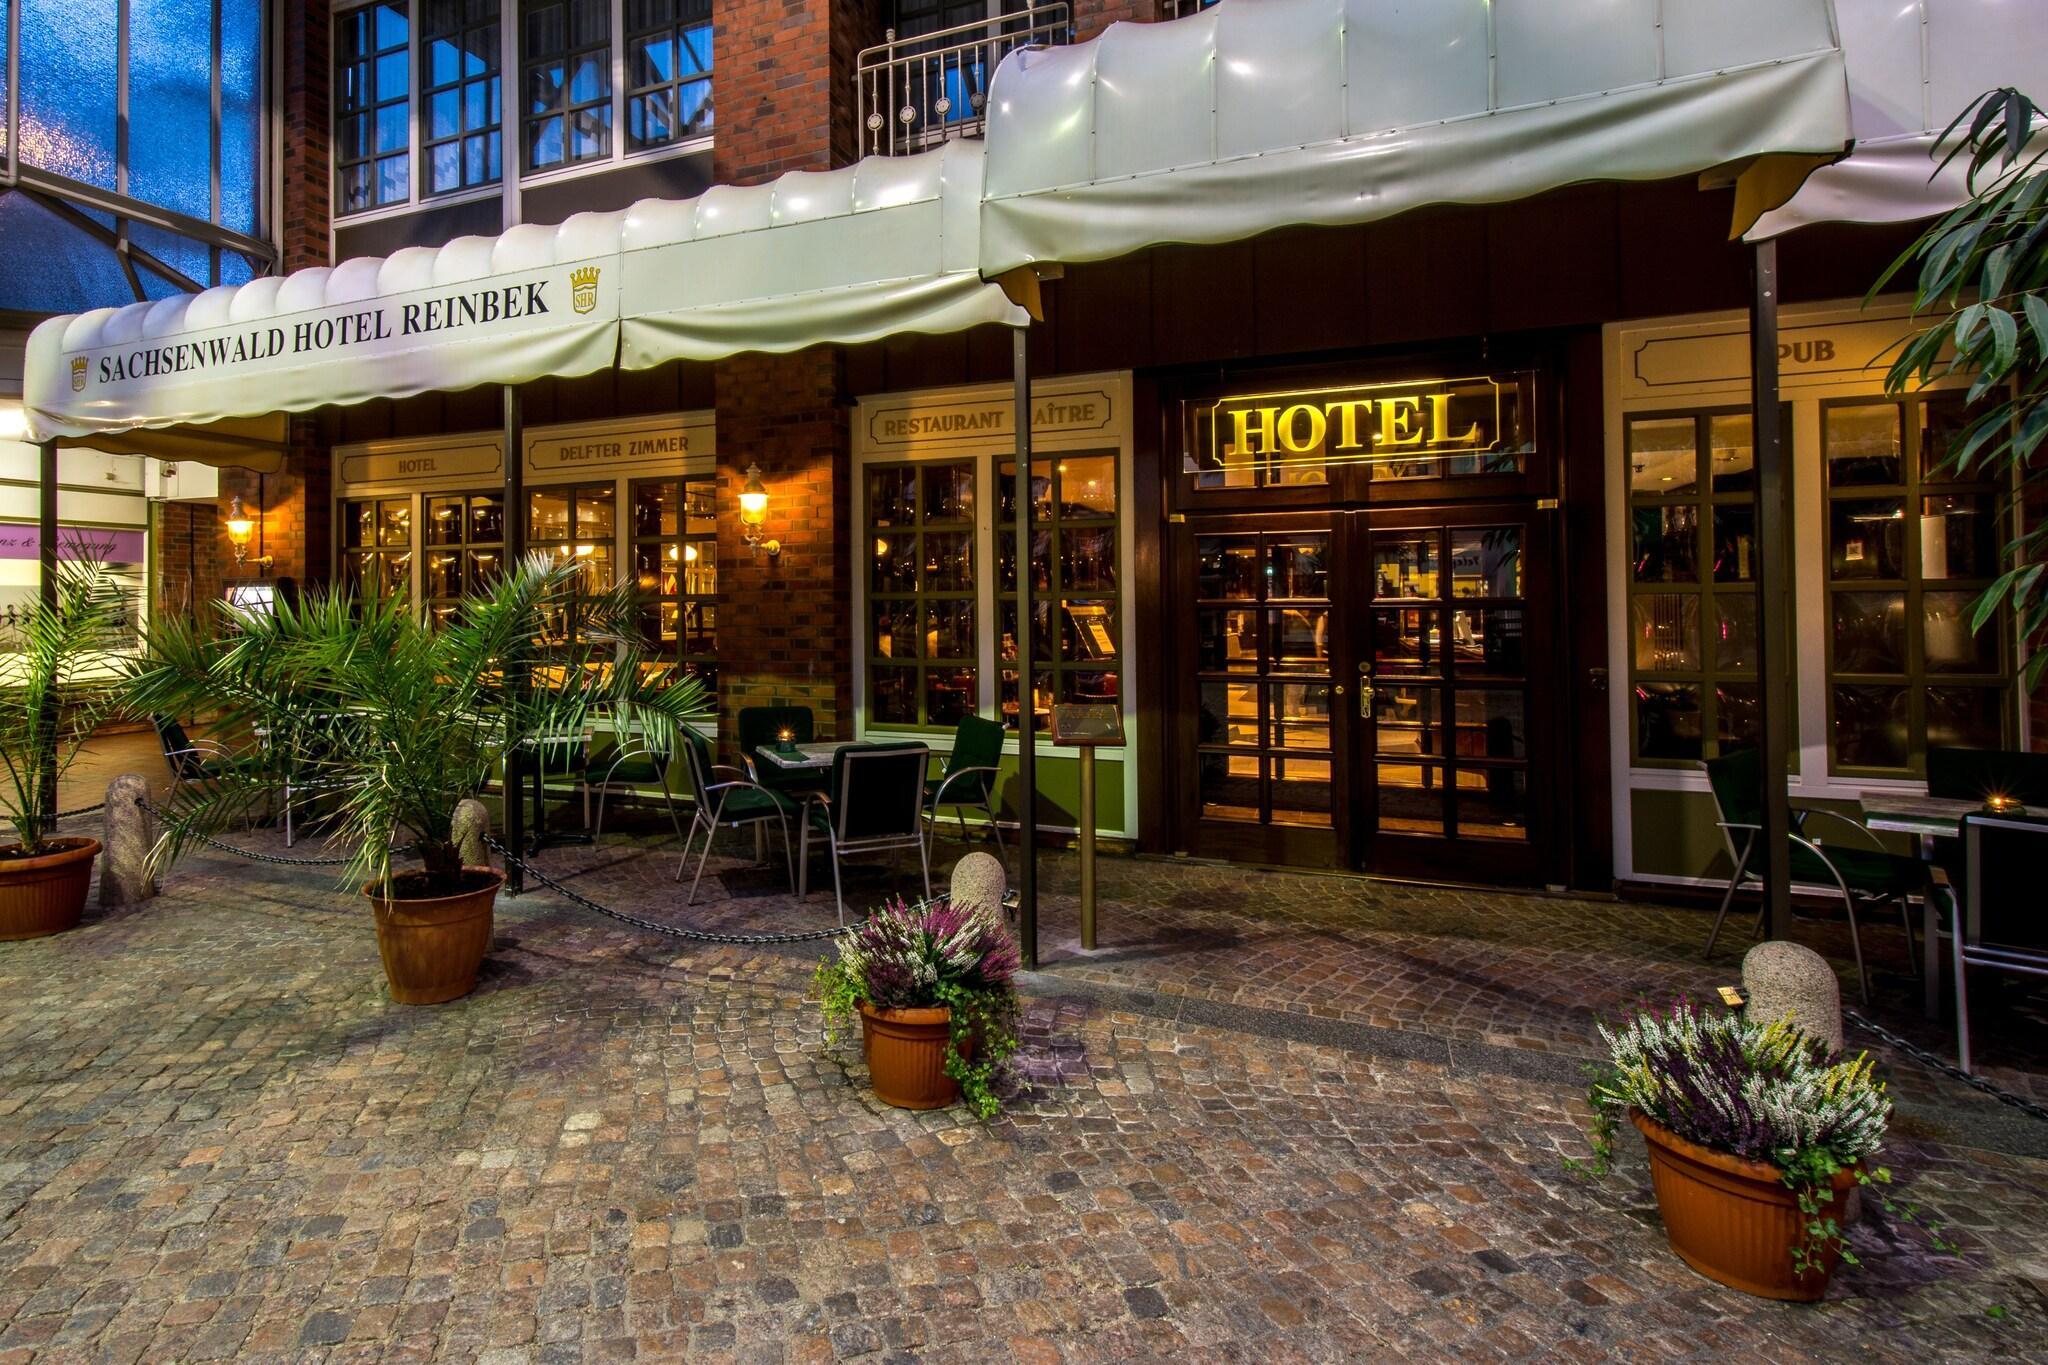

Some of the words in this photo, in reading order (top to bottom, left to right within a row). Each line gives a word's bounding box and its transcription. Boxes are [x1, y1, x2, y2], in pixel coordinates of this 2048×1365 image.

[576, 291, 594, 308] SHR
[100, 328, 285, 383] SACHSENWALD
[293, 309, 391, 353] HOTEL
[401, 280, 549, 336] REINBEK
[884, 411, 1004, 436] RESTAURANT
[1032, 403, 1096, 426] AÎTRE
[1228, 393, 1477, 455] HOTEL
[559, 442, 621, 461] DELFTER
[628, 437, 689, 456] ZIMMER
[398, 458, 437, 474] HOTEL
